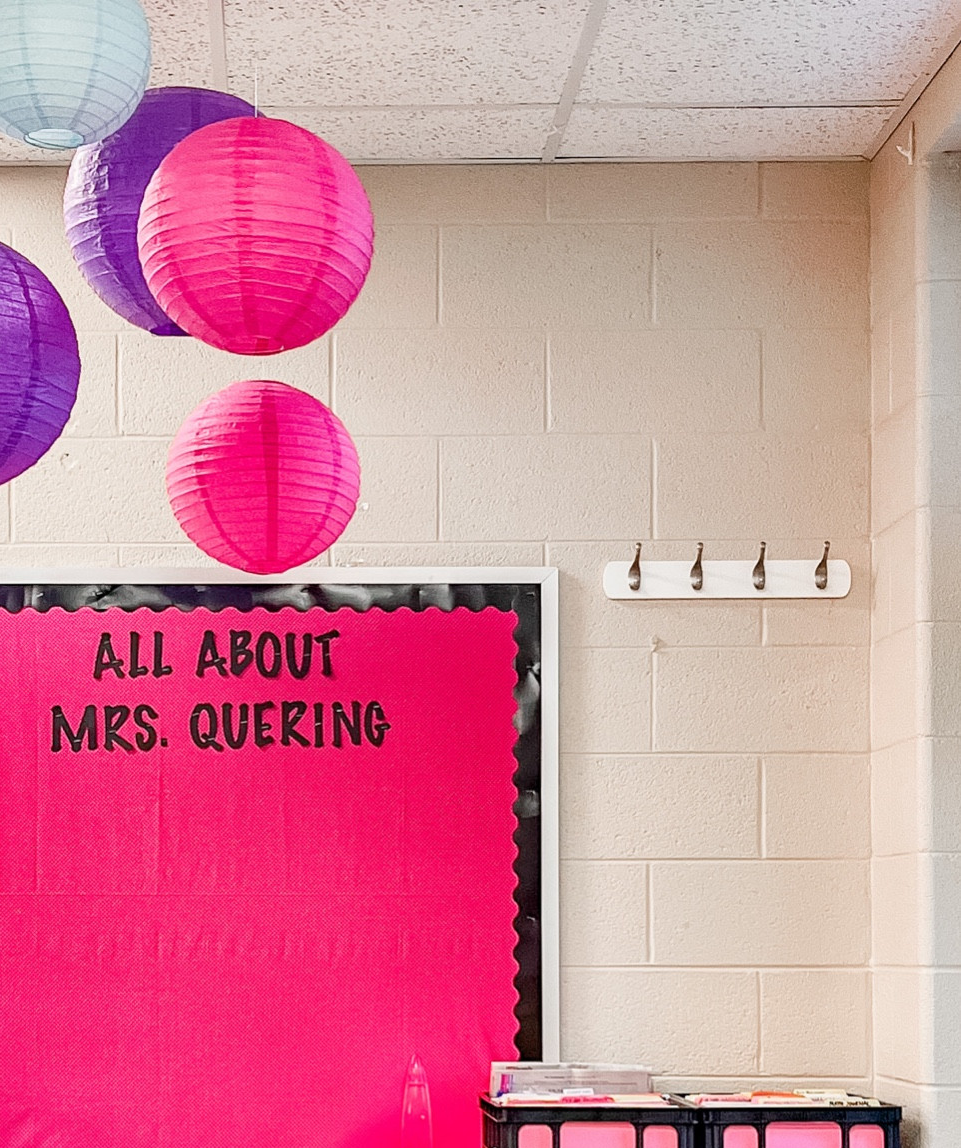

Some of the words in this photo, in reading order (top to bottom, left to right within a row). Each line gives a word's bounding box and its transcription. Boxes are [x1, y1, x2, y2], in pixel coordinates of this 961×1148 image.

[93, 631, 173, 680] ALL
[195, 629, 340, 680] ABOUT
[50, 704, 169, 753] MRS.
[189, 700, 392, 752] QUERING
